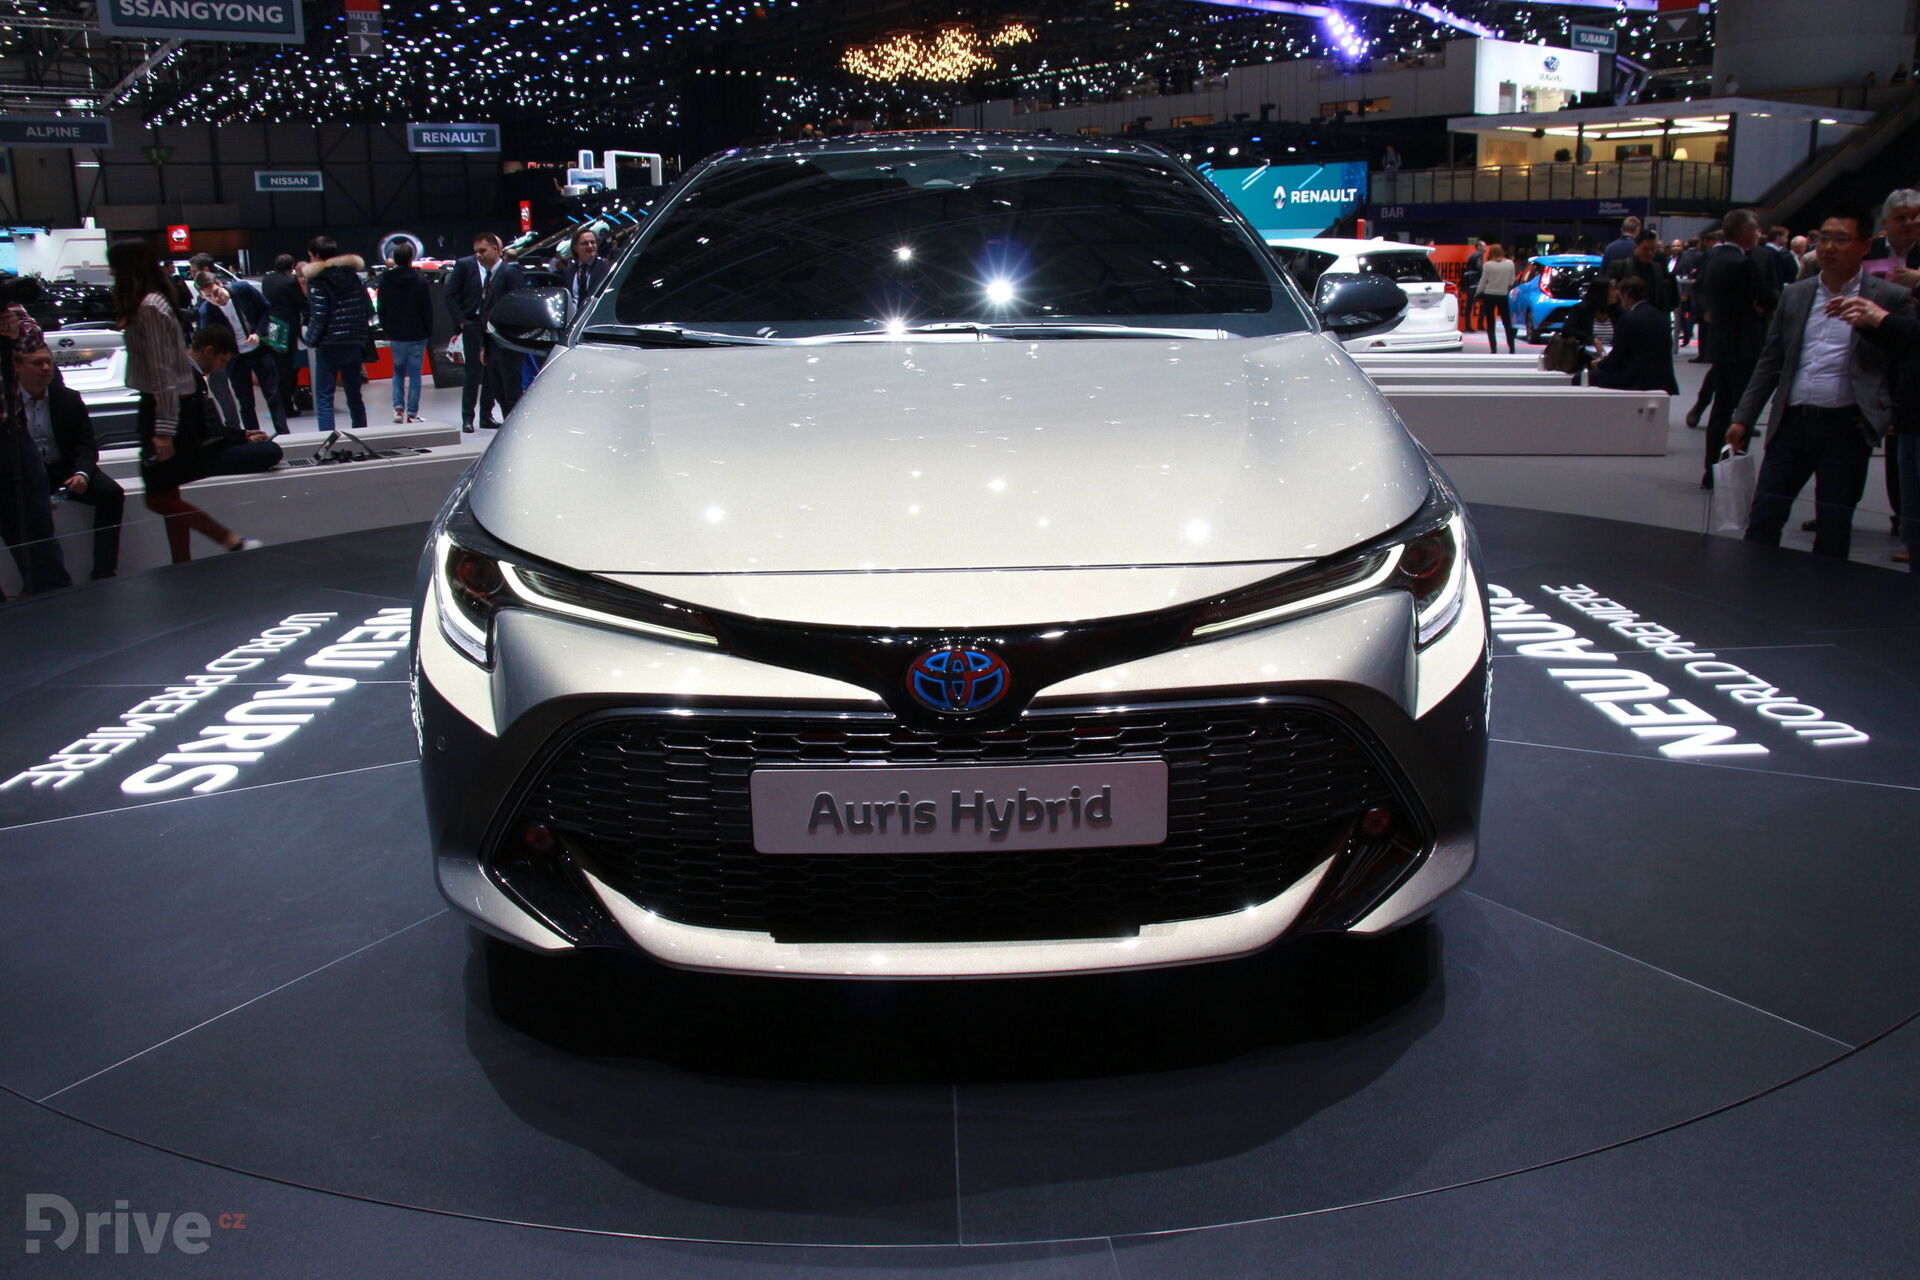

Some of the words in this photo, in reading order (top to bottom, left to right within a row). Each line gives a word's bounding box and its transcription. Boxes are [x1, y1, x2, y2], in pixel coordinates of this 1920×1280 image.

[119, 0, 284, 23] SSANGYONG
[350, 12, 379, 21] HALLE
[360, 22, 369, 33] 3
[1580, 32, 1609, 45] SUBARU
[26, 126, 81, 138] ALPINE
[422, 131, 487, 144] RENAULT
[270, 176, 308, 186] NISSAN
[1290, 188, 1358, 204] RENAULT
[1380, 206, 1405, 219] BAR
[1540, 583, 1716, 660] PREMIERE
[204, 612, 339, 672] WORLD
[1547, 667, 1770, 759] NEW
[1684, 660, 1870, 747] WORLD
[0, 674, 238, 791] PREMIERE
[120, 673, 357, 795] AURIS
[807, 790, 938, 833] Auris
[950, 784, 1113, 840] Hybrid
